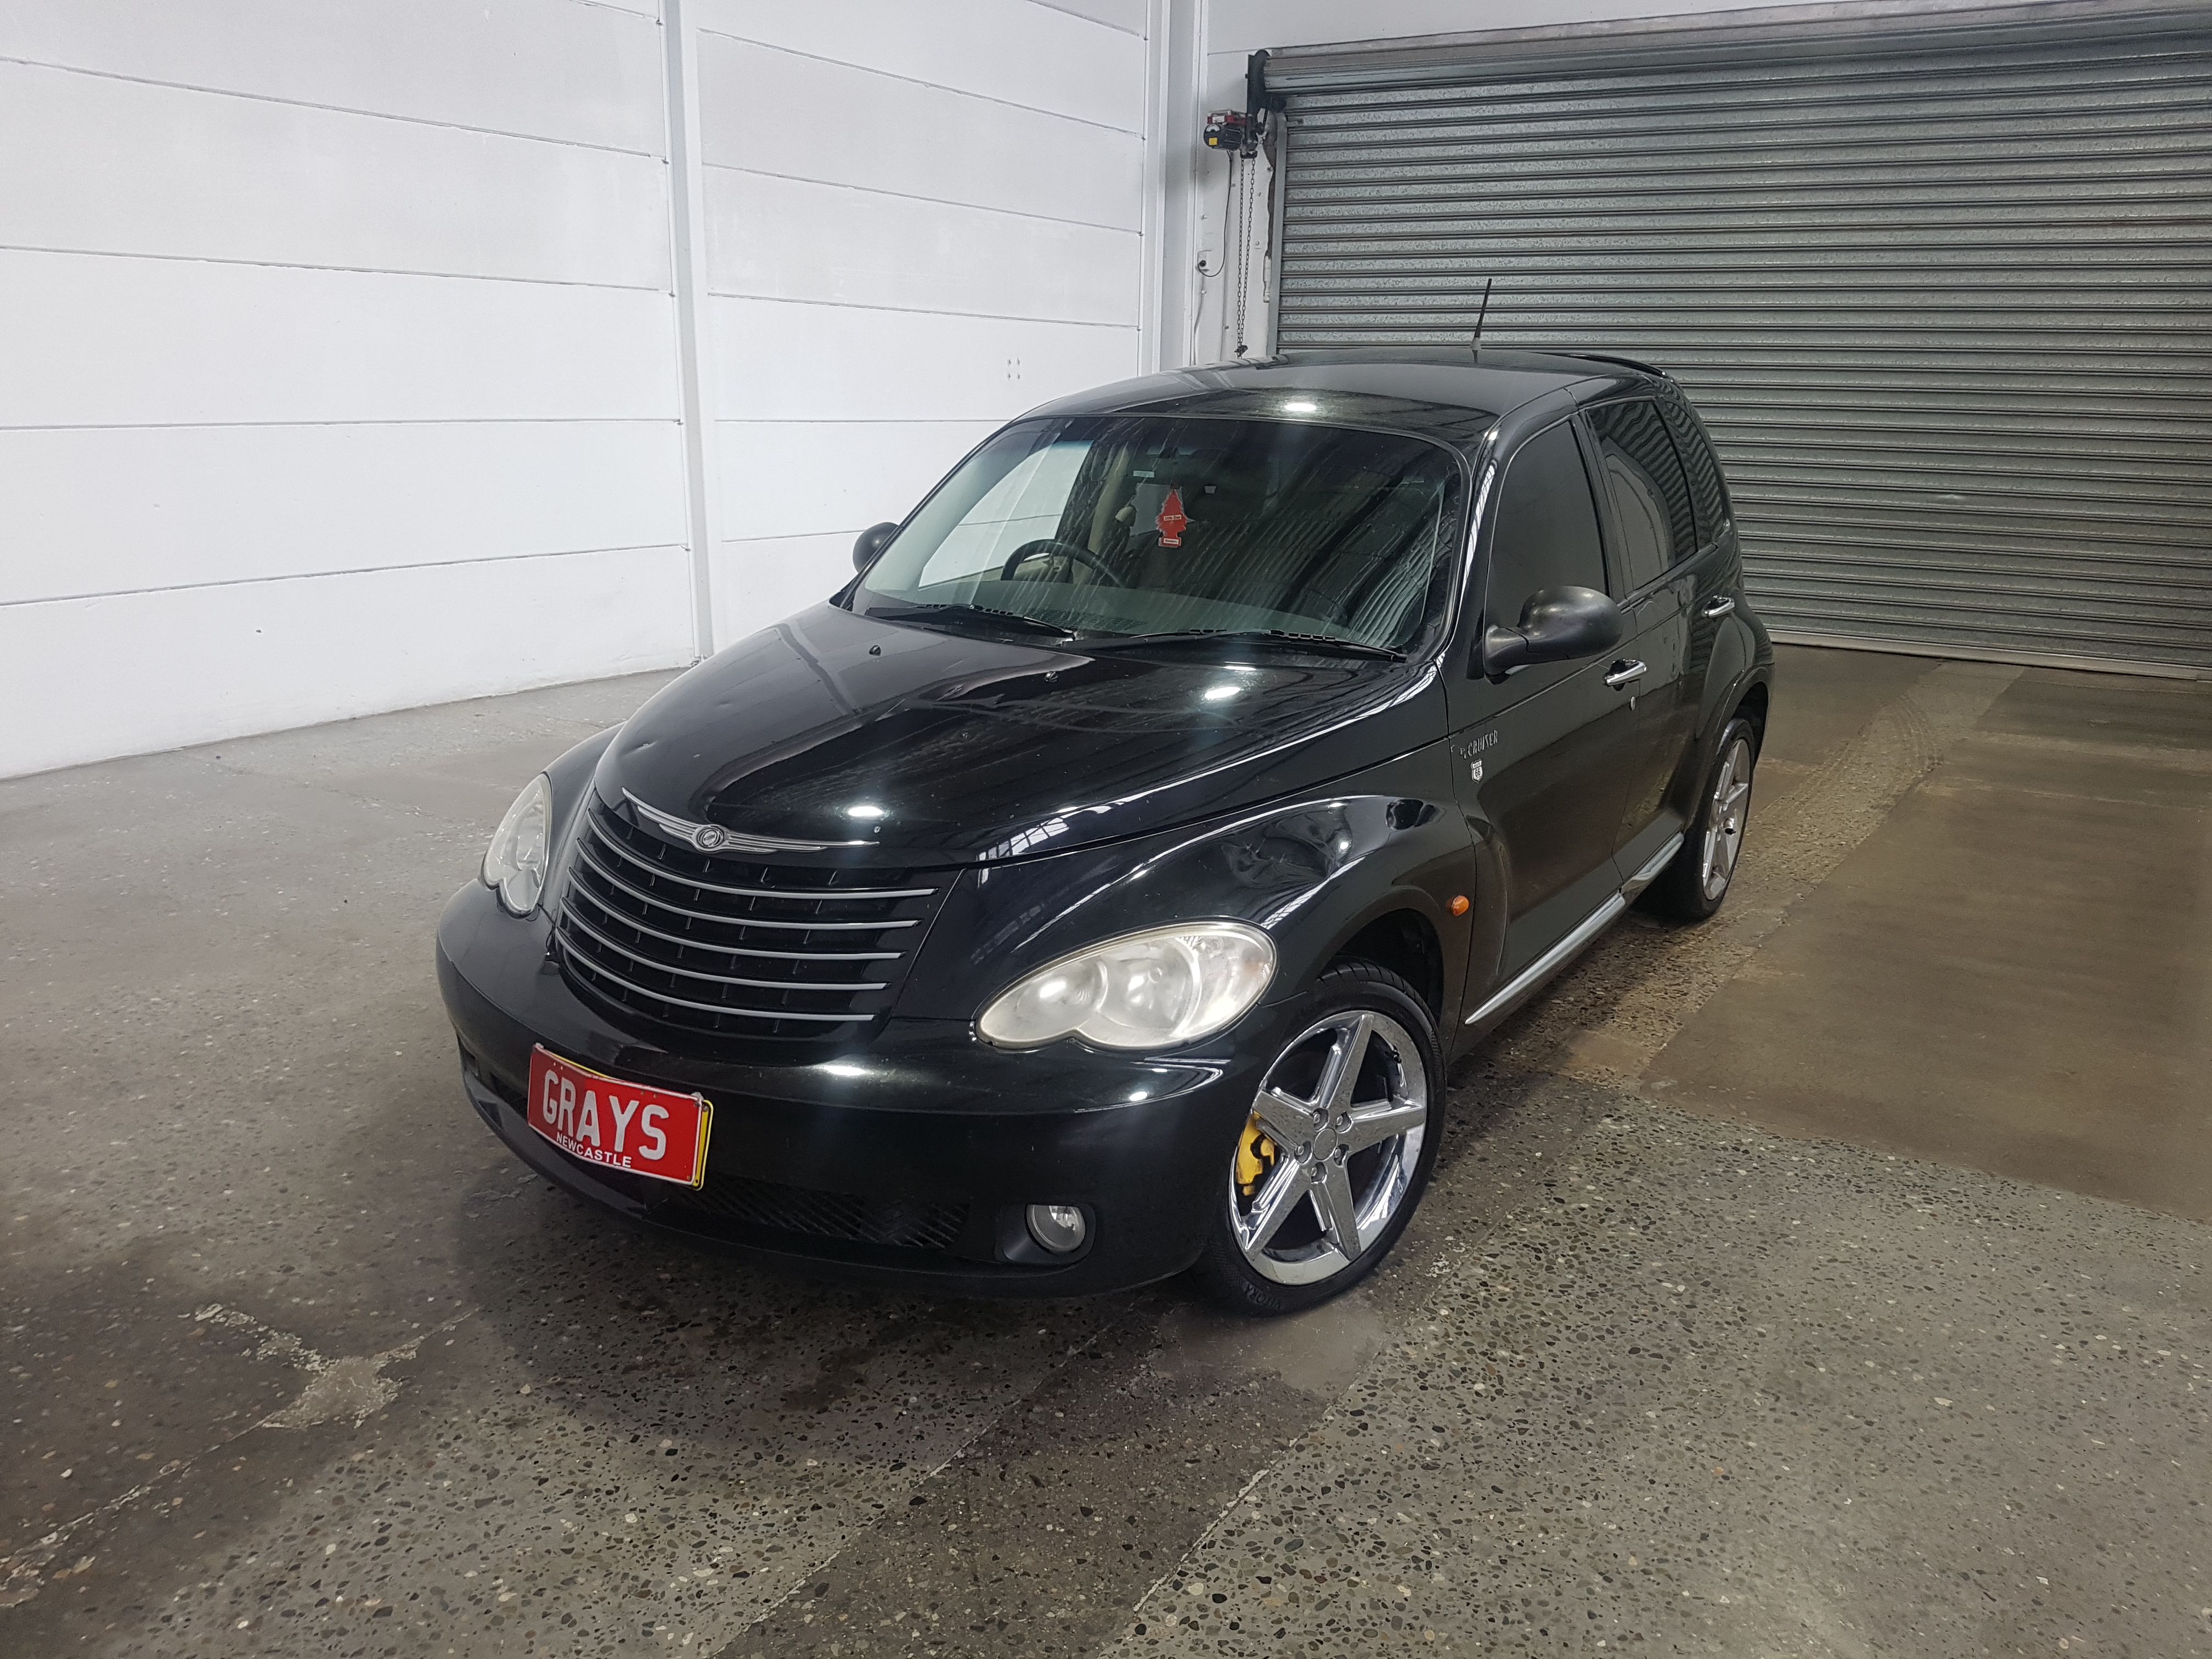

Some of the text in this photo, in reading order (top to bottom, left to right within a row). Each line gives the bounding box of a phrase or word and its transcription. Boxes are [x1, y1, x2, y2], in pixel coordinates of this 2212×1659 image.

[1468, 730, 1498, 757] CRUISER
[1475, 768, 1481, 777] 66
[543, 1069, 669, 1160] GRAYS
[556, 1131, 632, 1168] NEWCASTLE
